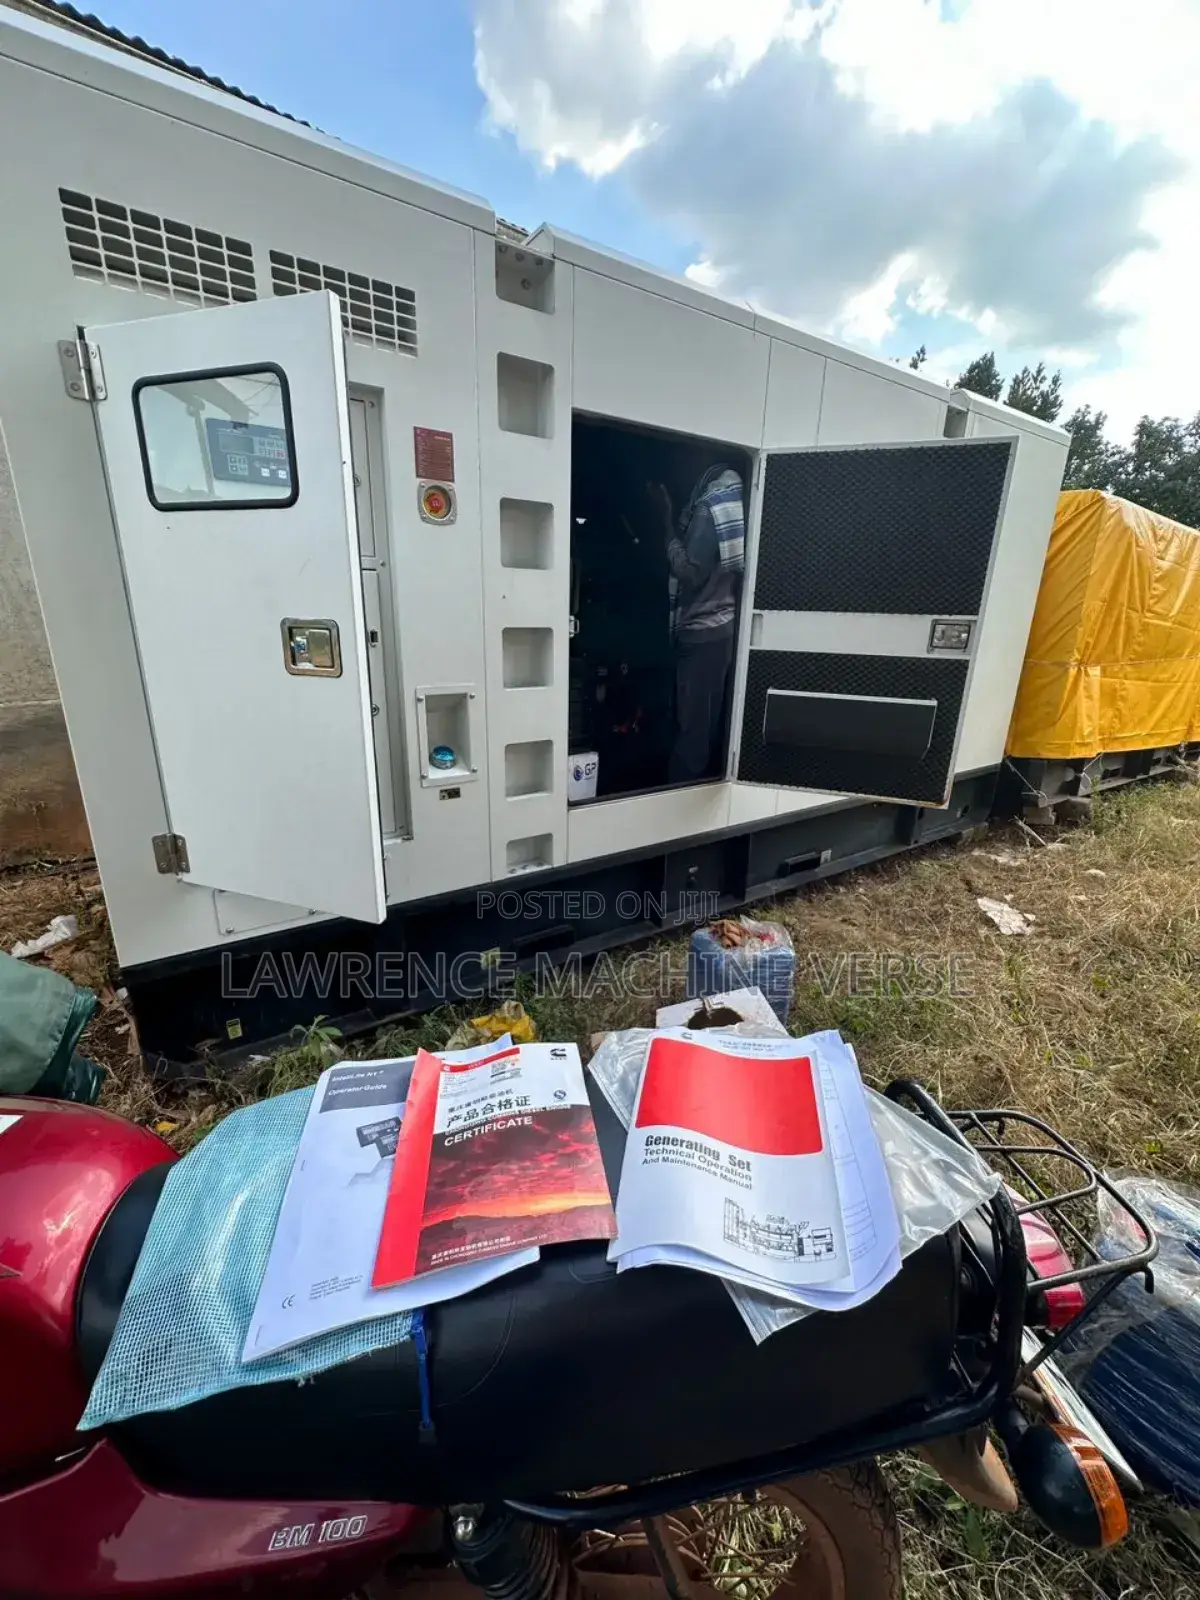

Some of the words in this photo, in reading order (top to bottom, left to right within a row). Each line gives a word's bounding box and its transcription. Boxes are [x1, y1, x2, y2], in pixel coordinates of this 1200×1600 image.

[446, 1095, 531, 1128] 产品合格证
[444, 1115, 533, 1147] CERTIFICATE
[643, 1146, 696, 1161] Technical
[697, 1155, 753, 1183] Operation
[644, 1134, 721, 1162] Generating
[728, 1154, 753, 1172] Set
[641, 1155, 660, 1166] And
[661, 1156, 718, 1178] Maintenance
[719, 1172, 753, 1191] Manual
[268, 1523, 315, 1552] BM
[317, 1515, 369, 1543] 100
